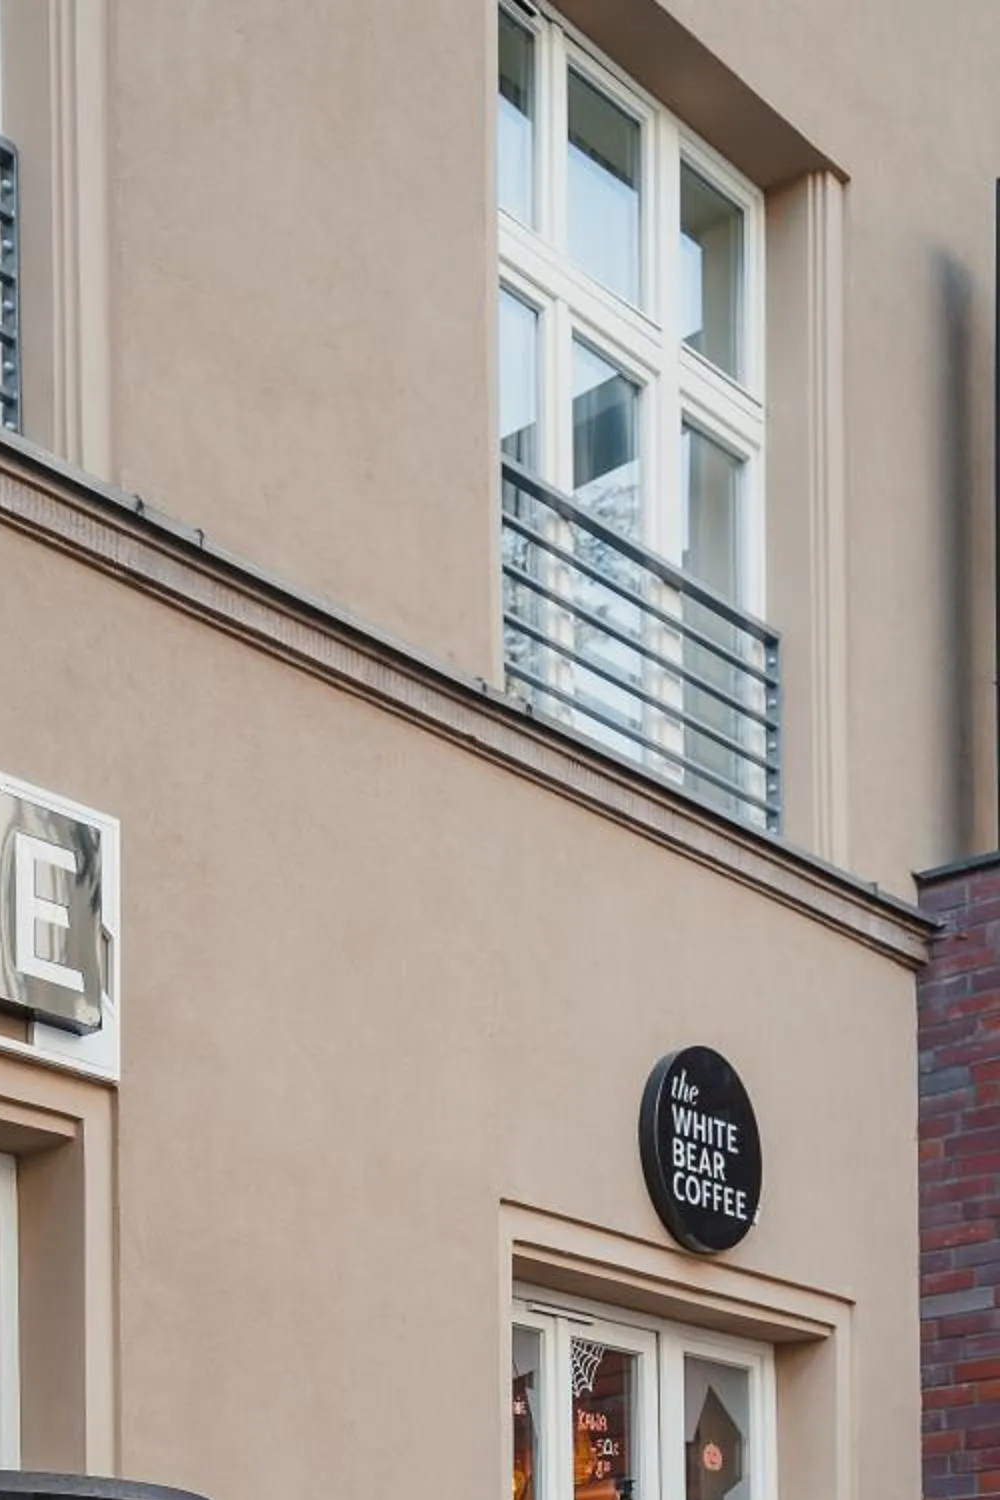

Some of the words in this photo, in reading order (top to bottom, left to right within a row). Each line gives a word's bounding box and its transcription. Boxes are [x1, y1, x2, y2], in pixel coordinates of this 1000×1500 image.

[671, 1068, 700, 1105] the
[671, 1103, 740, 1154] WHITE
[672, 1137, 726, 1181] BEAR
[673, 1171, 748, 1221] COFFEE
